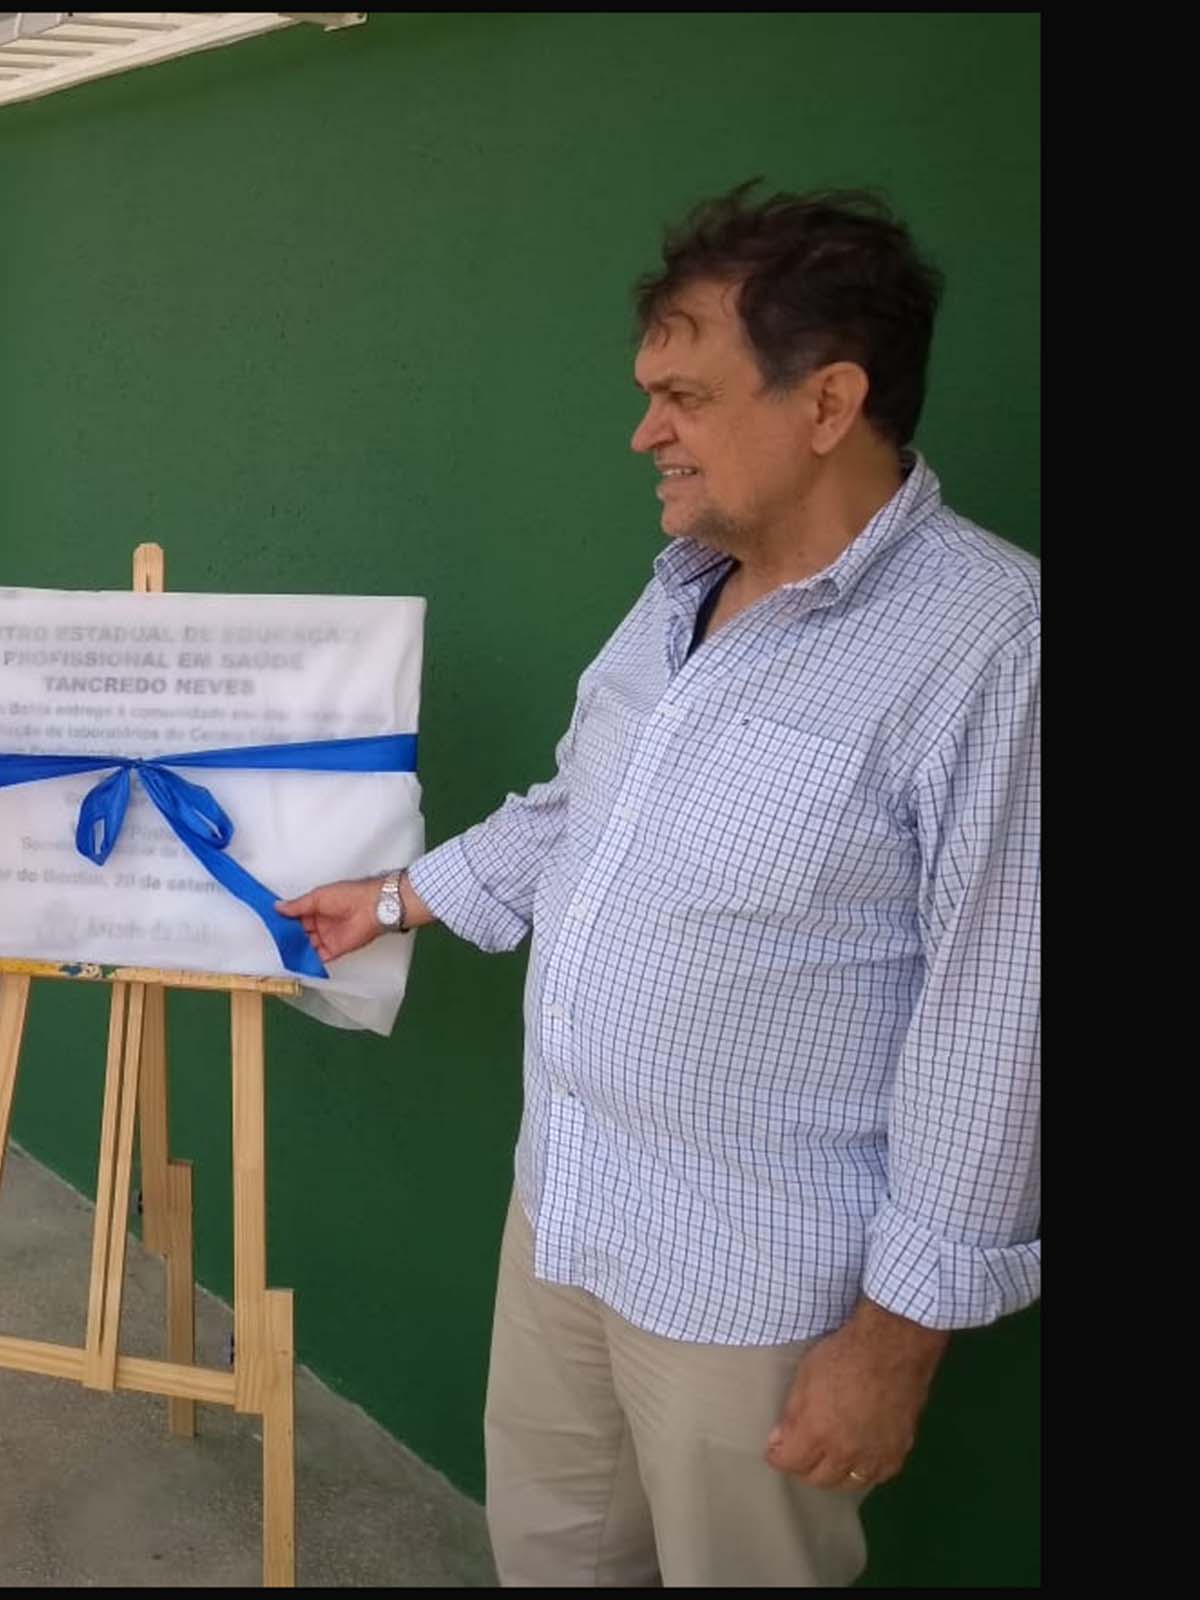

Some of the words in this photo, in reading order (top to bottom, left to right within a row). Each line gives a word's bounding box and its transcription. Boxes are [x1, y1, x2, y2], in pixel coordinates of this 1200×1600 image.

[55, 625, 173, 643] ESTADUAL
[184, 625, 212, 643] DE
[3, 650, 169, 669] PROFISSIONAL
[178, 651, 213, 670] EM
[221, 648, 305, 671] SAÚDE
[44, 676, 167, 695] TANCREDO
[175, 678, 257, 697] NEVES
